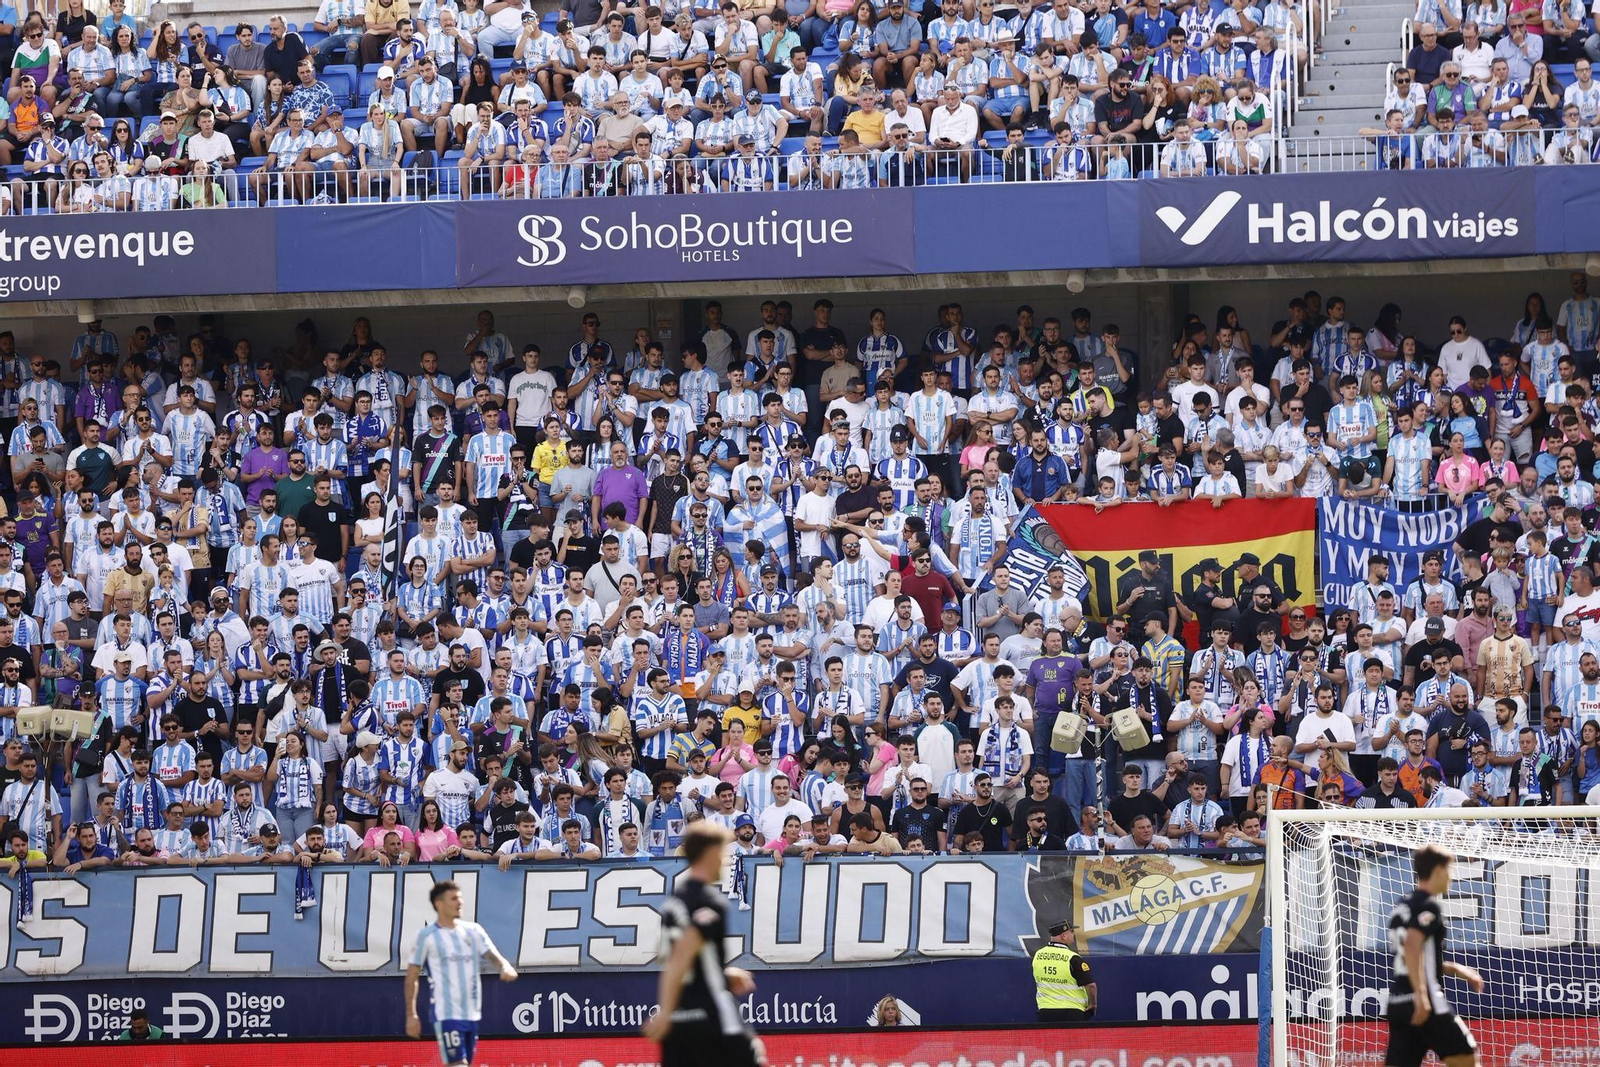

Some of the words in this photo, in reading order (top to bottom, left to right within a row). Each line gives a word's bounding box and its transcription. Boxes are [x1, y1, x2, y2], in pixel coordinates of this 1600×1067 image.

[1248, 196, 1427, 243] Halcón
[1433, 212, 1518, 243] viajes
[580, 210, 852, 257] SohoBoutique
[0, 229, 195, 267] trevenque
[682, 249, 740, 263] HOTELS
[0, 274, 61, 297] group
[484, 455, 506, 463] Tivoli
[1322, 495, 1387, 544] MUY
[1324, 538, 1340, 575] Y
[1562, 555, 1588, 565] málaga
[298, 579, 326, 588] MARATHON
[386, 700, 407, 709] Tivoli
[1580, 702, 1600, 710] Tivol
[649, 713, 674, 725] MALAGA
[1092, 884, 1186, 926] MALAGA
[1190, 874, 1228, 897] C.F.
[127, 872, 277, 973] DE
[1036, 952, 1070, 963] SEGURIDAD
[1043, 966, 1057, 976] 155
[1040, 977, 1068, 985] PROSEGUR
[88, 993, 146, 1014] Diego
[227, 992, 285, 1012] Diego
[739, 992, 838, 1024] dalucía
[88, 1012, 131, 1029] Díaz
[227, 1011, 271, 1028] Díaz
[444, 1030, 461, 1048] 16
